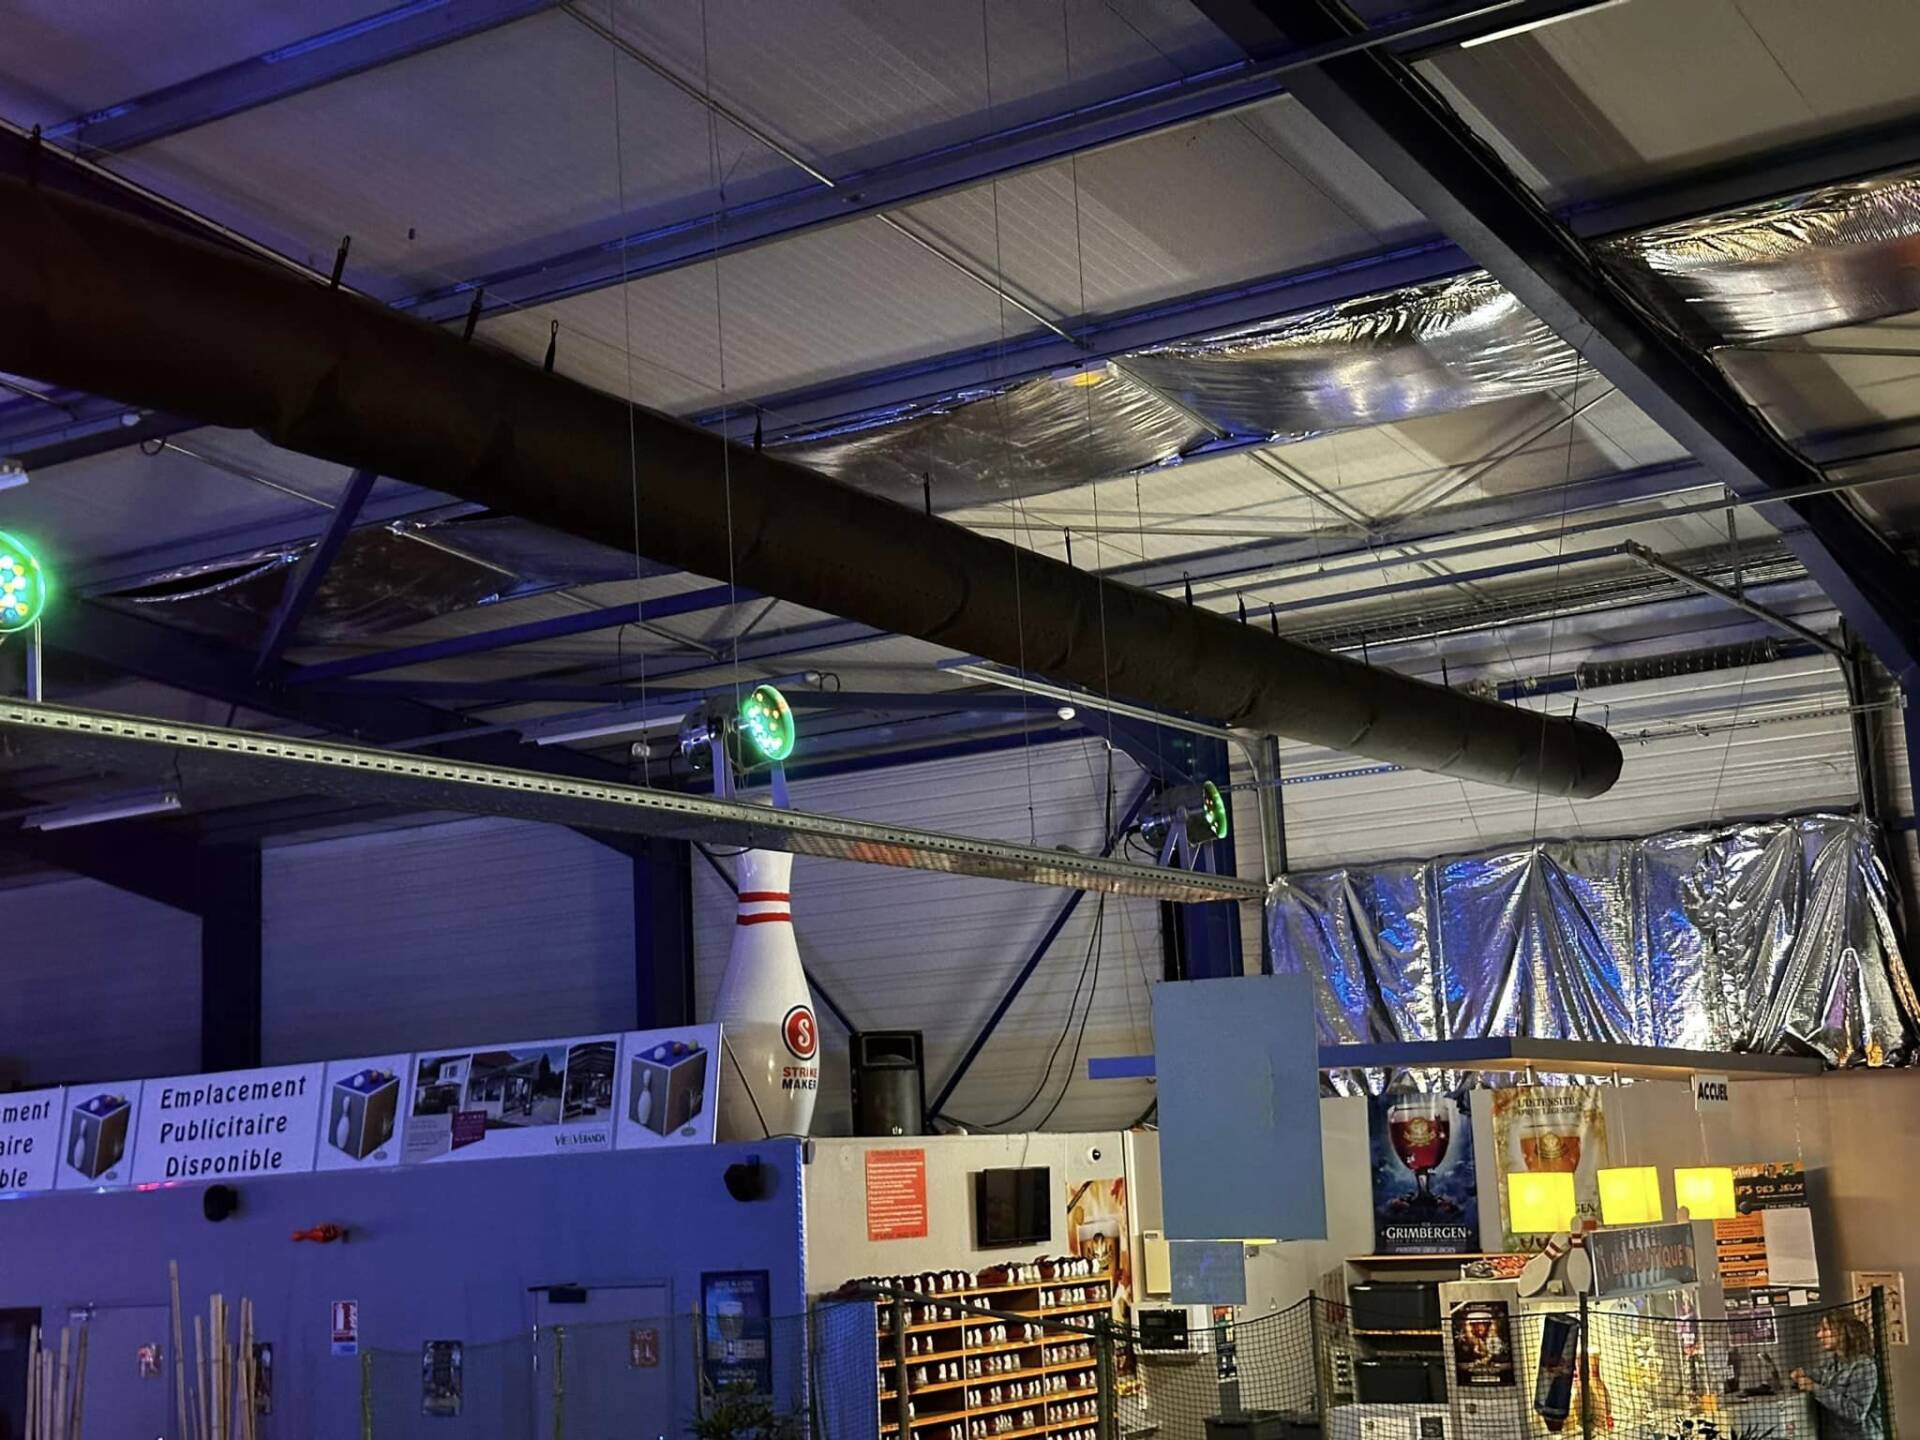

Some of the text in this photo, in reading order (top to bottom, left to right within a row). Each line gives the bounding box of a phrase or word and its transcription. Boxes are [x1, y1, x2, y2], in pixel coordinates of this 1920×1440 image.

[161, 1076, 306, 1109] Emplacement
[0, 1100, 50, 1123] ment
[160, 1113, 288, 1144] Publicitaire
[166, 1148, 282, 1178] Disponible
[1386, 1226, 1467, 1239] GRIMBERGEN
